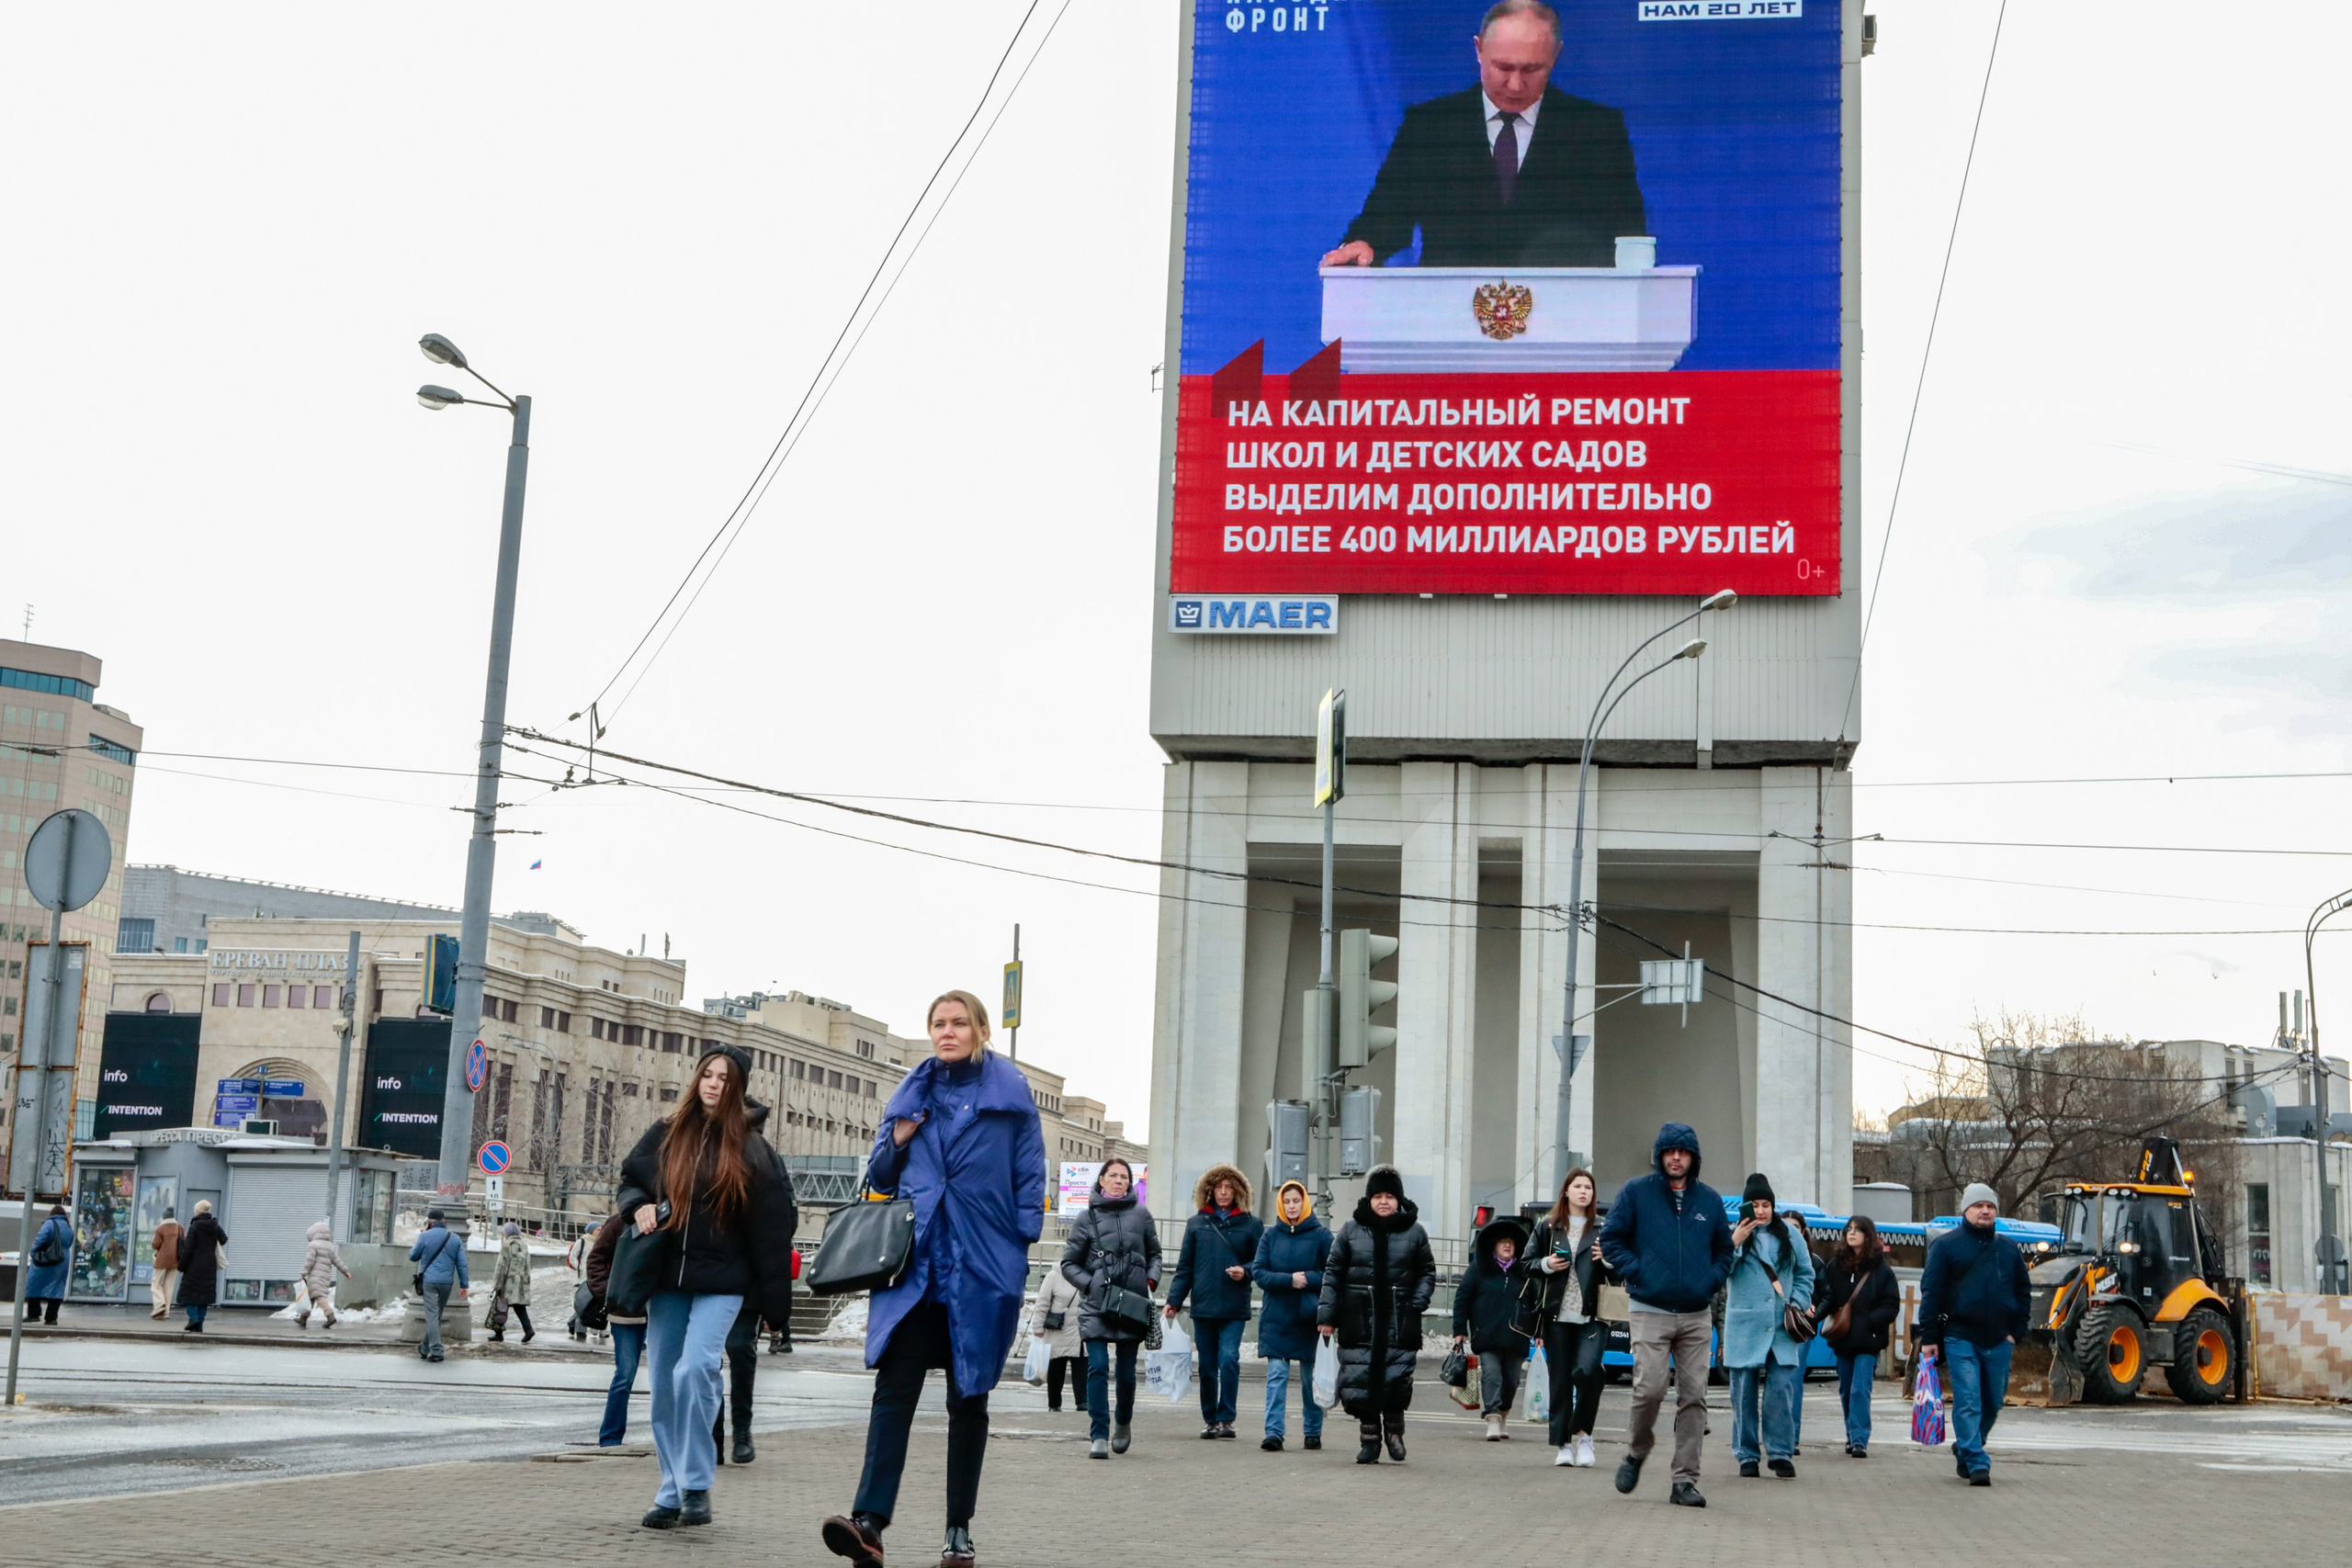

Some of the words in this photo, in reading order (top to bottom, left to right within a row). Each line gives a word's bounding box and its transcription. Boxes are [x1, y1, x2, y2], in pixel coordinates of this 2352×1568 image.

[1226, 6, 1329, 32] ФРОНТ
[1644, 4, 1700, 17] НАМ
[1708, 3, 1741, 16] 20
[1747, 2, 1797, 15] ЛЕТ
[1227, 400, 1272, 426] НА
[1282, 393, 1540, 426] КАПИТАЛЬНЫЙ
[1551, 398, 1690, 424] РЕМОНТ
[1227, 442, 1325, 468] ШКОЛ
[1336, 442, 1357, 468] И
[1366, 441, 1523, 473] ДЕТСКИХ
[1532, 441, 1647, 472] САДОВ
[1225, 484, 1398, 515] ВЫДЕЛИМ
[1407, 483, 1712, 515] ДОПОЛНИТЕЛЬНО
[1223, 526, 1331, 552] БОЛЕЕ
[1340, 526, 1396, 552] 400
[1407, 526, 1647, 558] МИЛЛИАРДОВ
[1657, 521, 1794, 553] РУБЛЕЙ
[1797, 558, 1825, 580] 0+
[1209, 602, 1331, 628] MAER
[212, 952, 288, 969] ЕРЕВАН
[296, 953, 361, 971] ПЛАЗ
[104, 1069, 128, 1082] info
[377, 1077, 401, 1089] info
[151, 1130, 182, 1144] ПРЕССА
